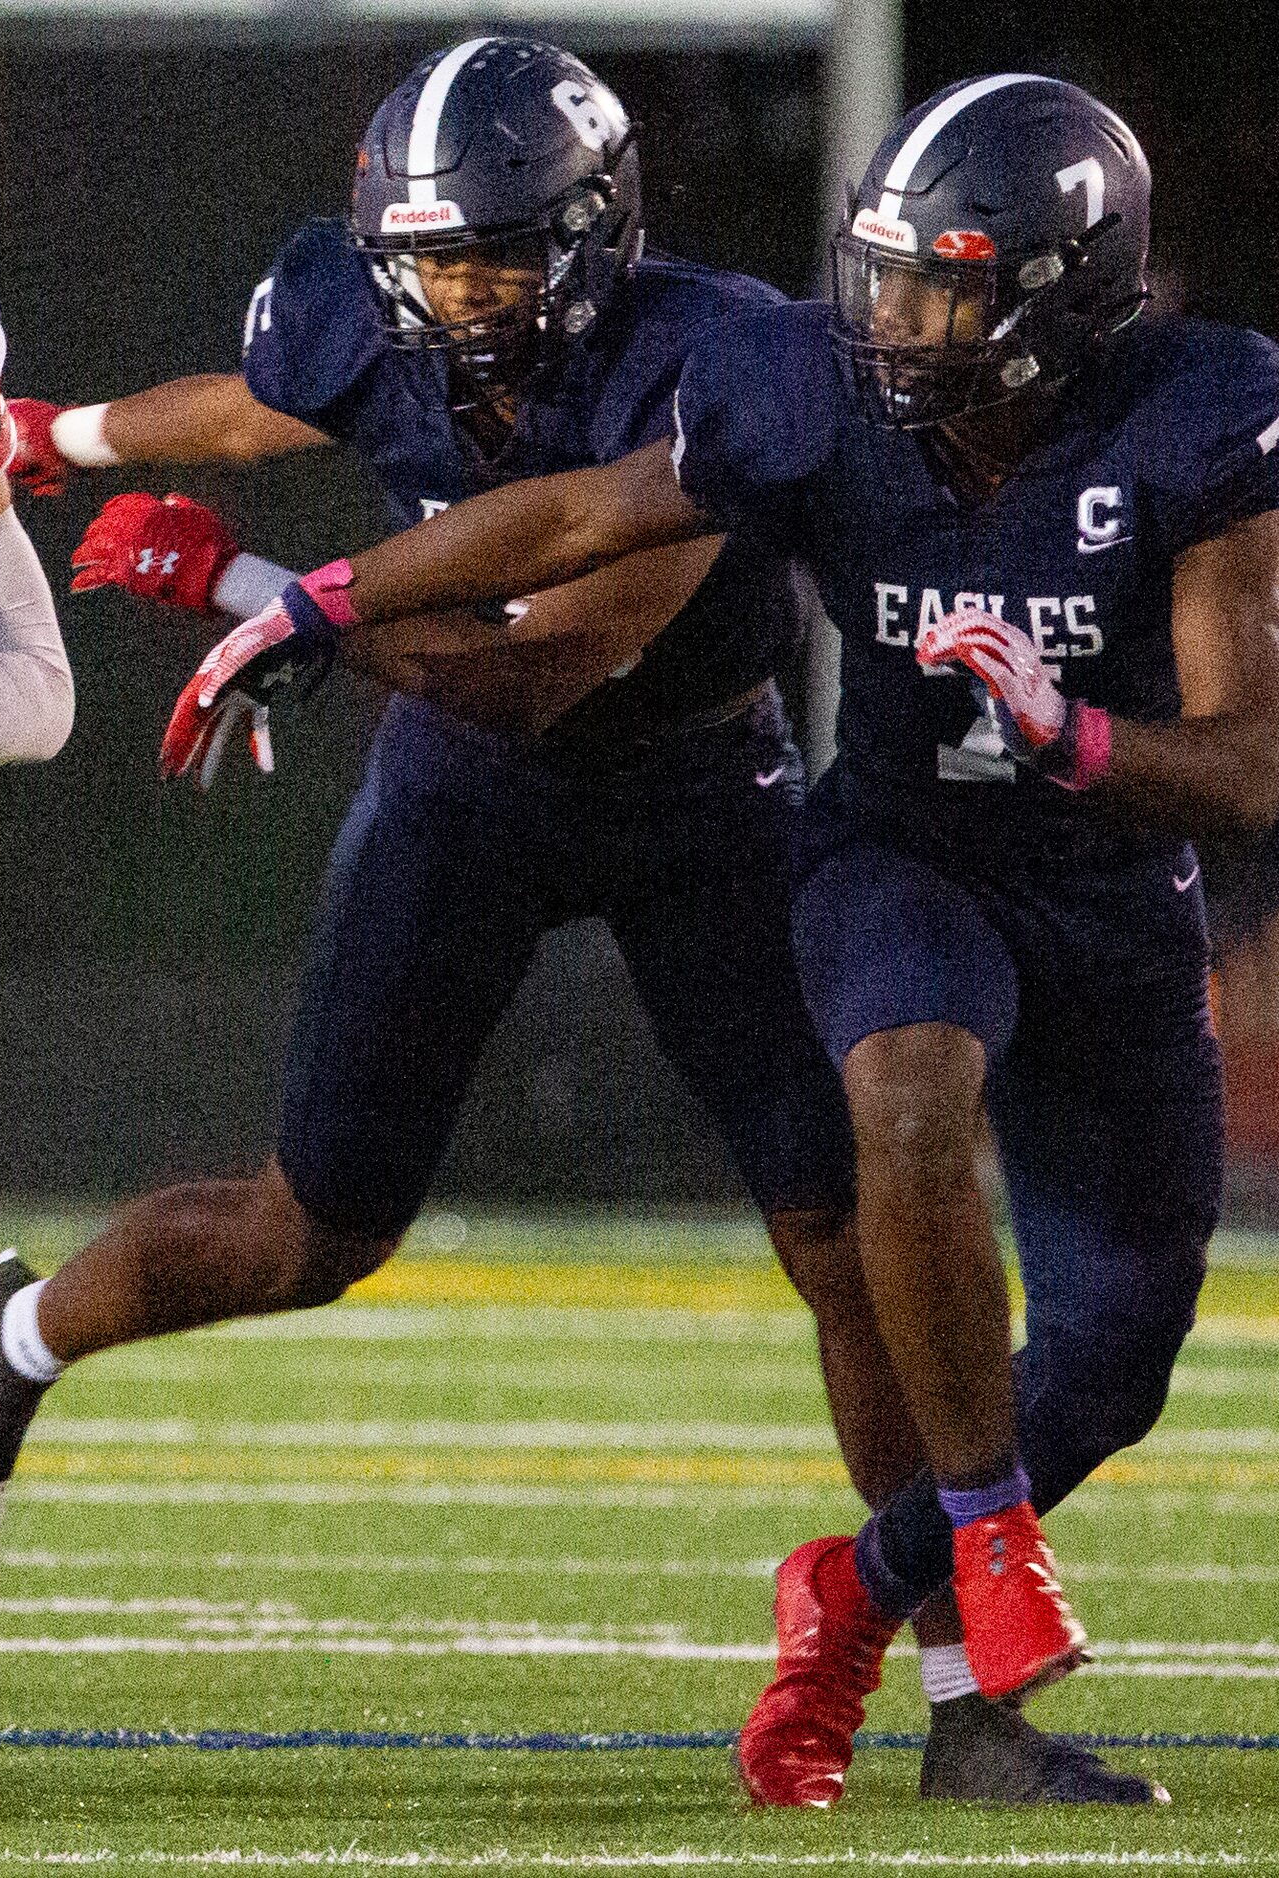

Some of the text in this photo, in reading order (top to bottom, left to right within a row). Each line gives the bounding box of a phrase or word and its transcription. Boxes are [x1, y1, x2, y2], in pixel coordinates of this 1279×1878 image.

[551, 79, 610, 152] 6
[390, 206, 451, 224] Riddell
[1055, 156, 1105, 229] 7
[1077, 485, 1123, 543] C
